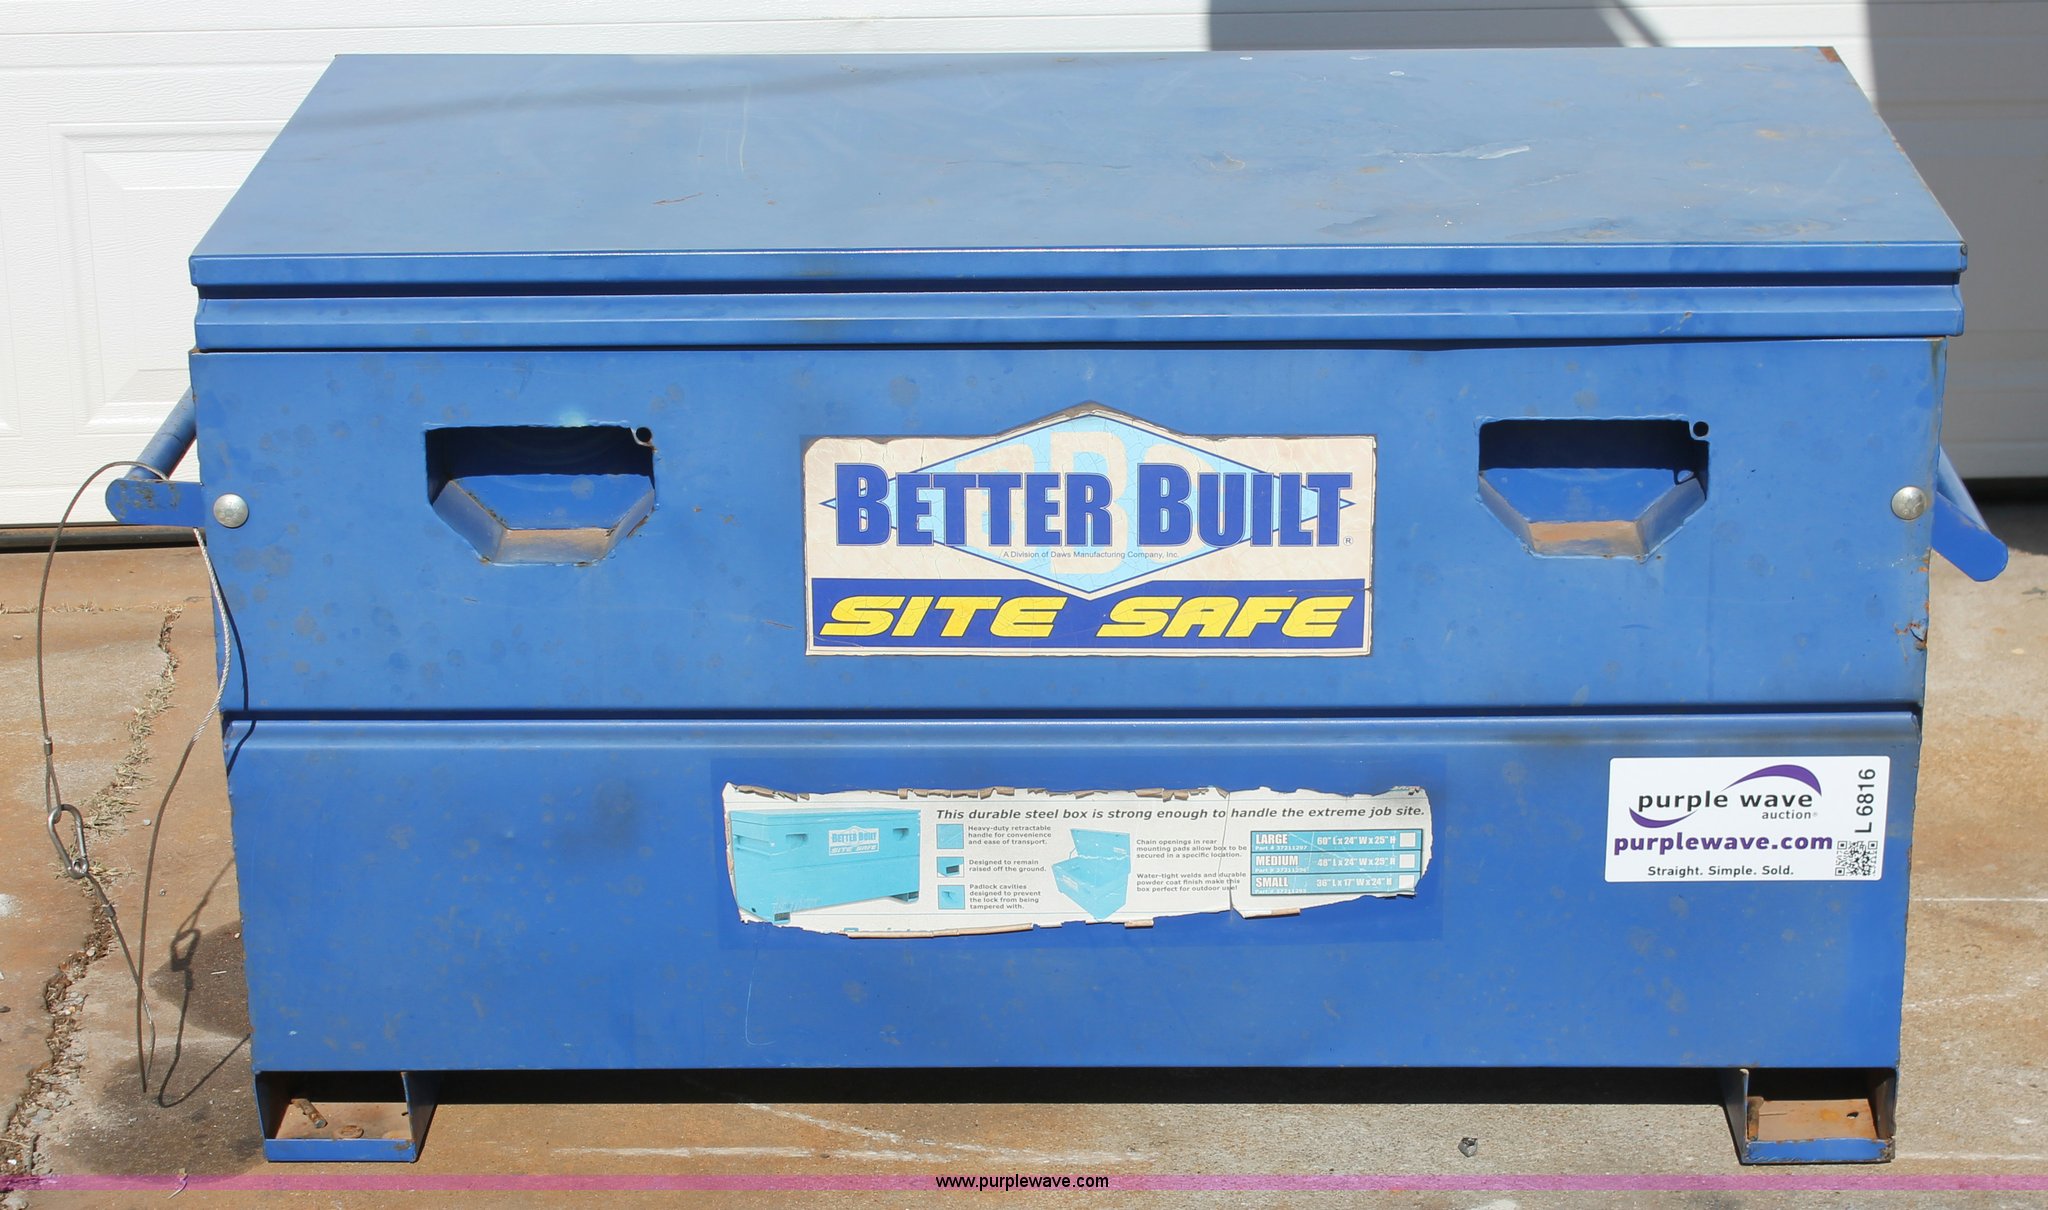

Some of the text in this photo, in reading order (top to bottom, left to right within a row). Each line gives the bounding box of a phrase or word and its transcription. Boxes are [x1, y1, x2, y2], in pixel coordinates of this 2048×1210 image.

[834, 462, 1113, 547] BETTER
[1137, 462, 1353, 547] BUILT
[1073, 551, 1125, 559] Manufacturing
[819, 596, 1355, 638] SITE SAFE
[1638, 790, 1813, 812] purple wave
[1854, 769, 1876, 833] L 6816
[936, 807, 1425, 820] This durable steel box is strong enough to handle the extreme job site.
[1762, 810, 1811, 819] auction
[1256, 834, 1288, 844] LARGE
[1614, 832, 1833, 856] purplewave.com
[1255, 855, 1299, 866] MEDIUM
[1648, 865, 1794, 878] Straight. Simple. Sold.
[1255, 877, 1288, 887] SMALL
